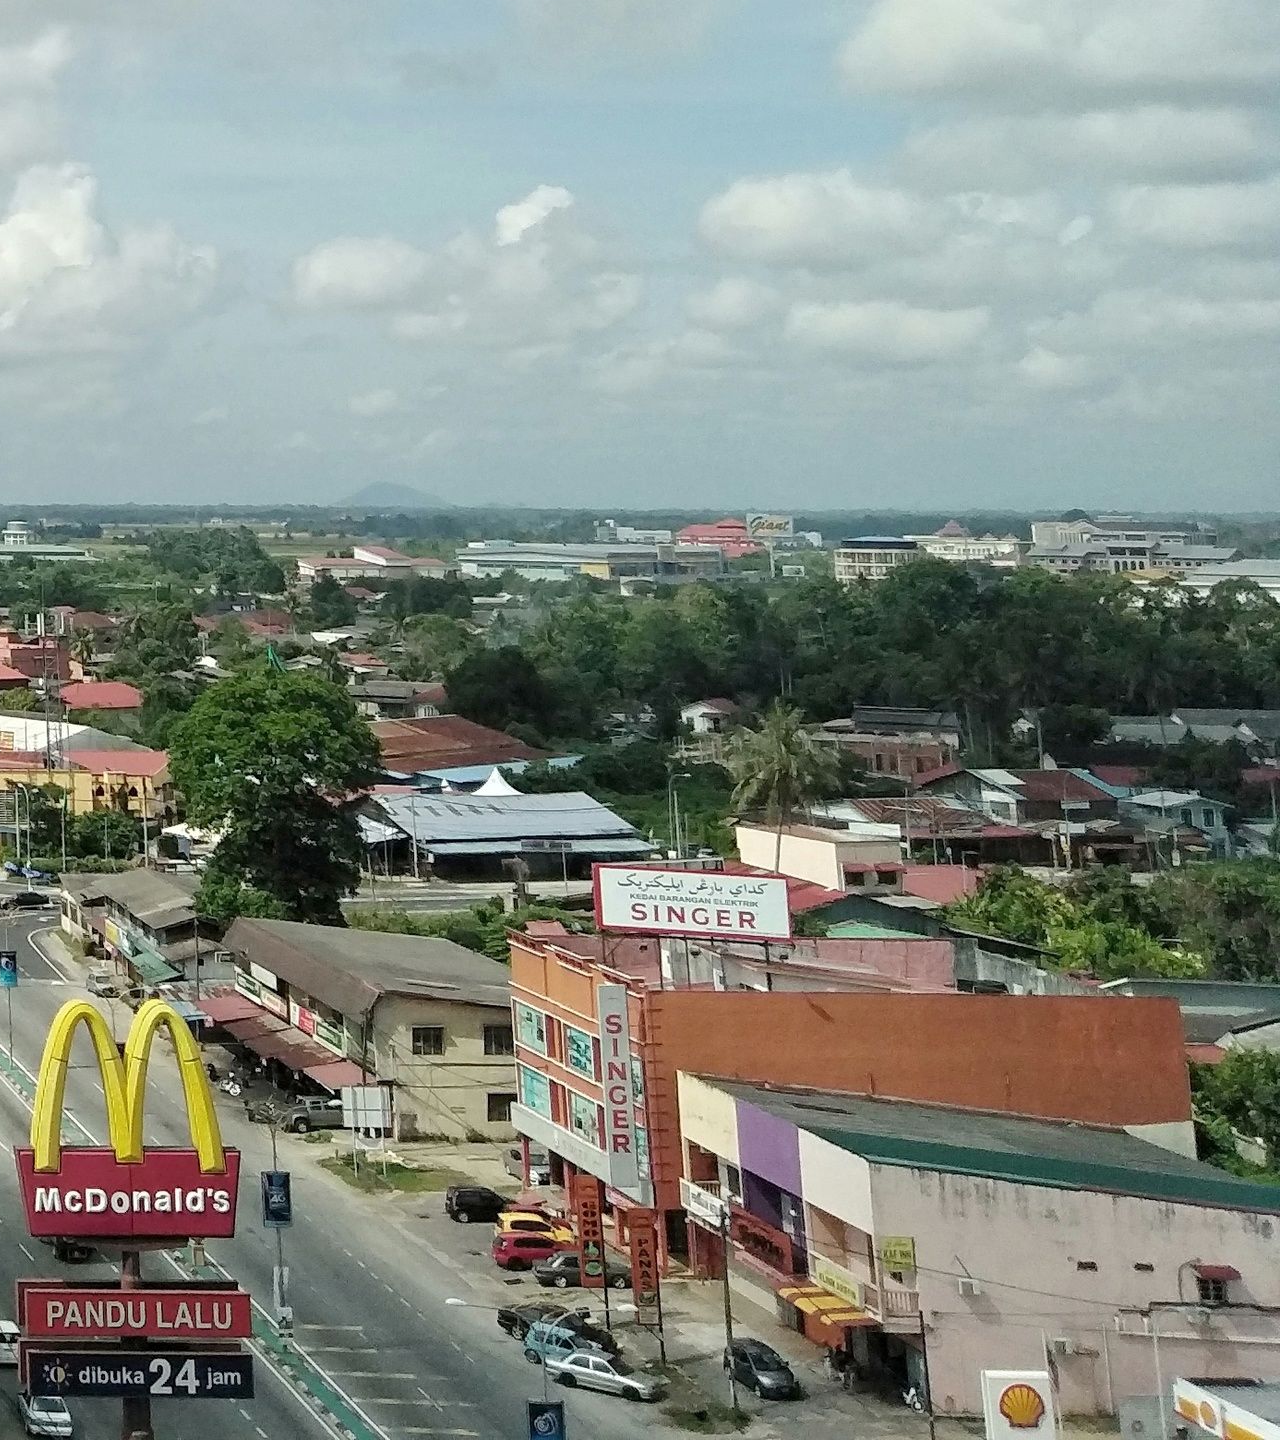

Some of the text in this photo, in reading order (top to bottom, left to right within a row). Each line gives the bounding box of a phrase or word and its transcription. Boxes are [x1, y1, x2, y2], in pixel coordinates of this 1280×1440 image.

[750, 516, 789, 535] Giant
[630, 893, 759, 908] KEDAI BARANGAN ELEKTRIK
[631, 902, 757, 929] SINGER
[605, 1014, 632, 1154] SINGER
[34, 1187, 231, 1214] McDonald's
[46, 1300, 233, 1330] PANDU LALU
[78, 1357, 242, 1396] dibuka 24 jam
